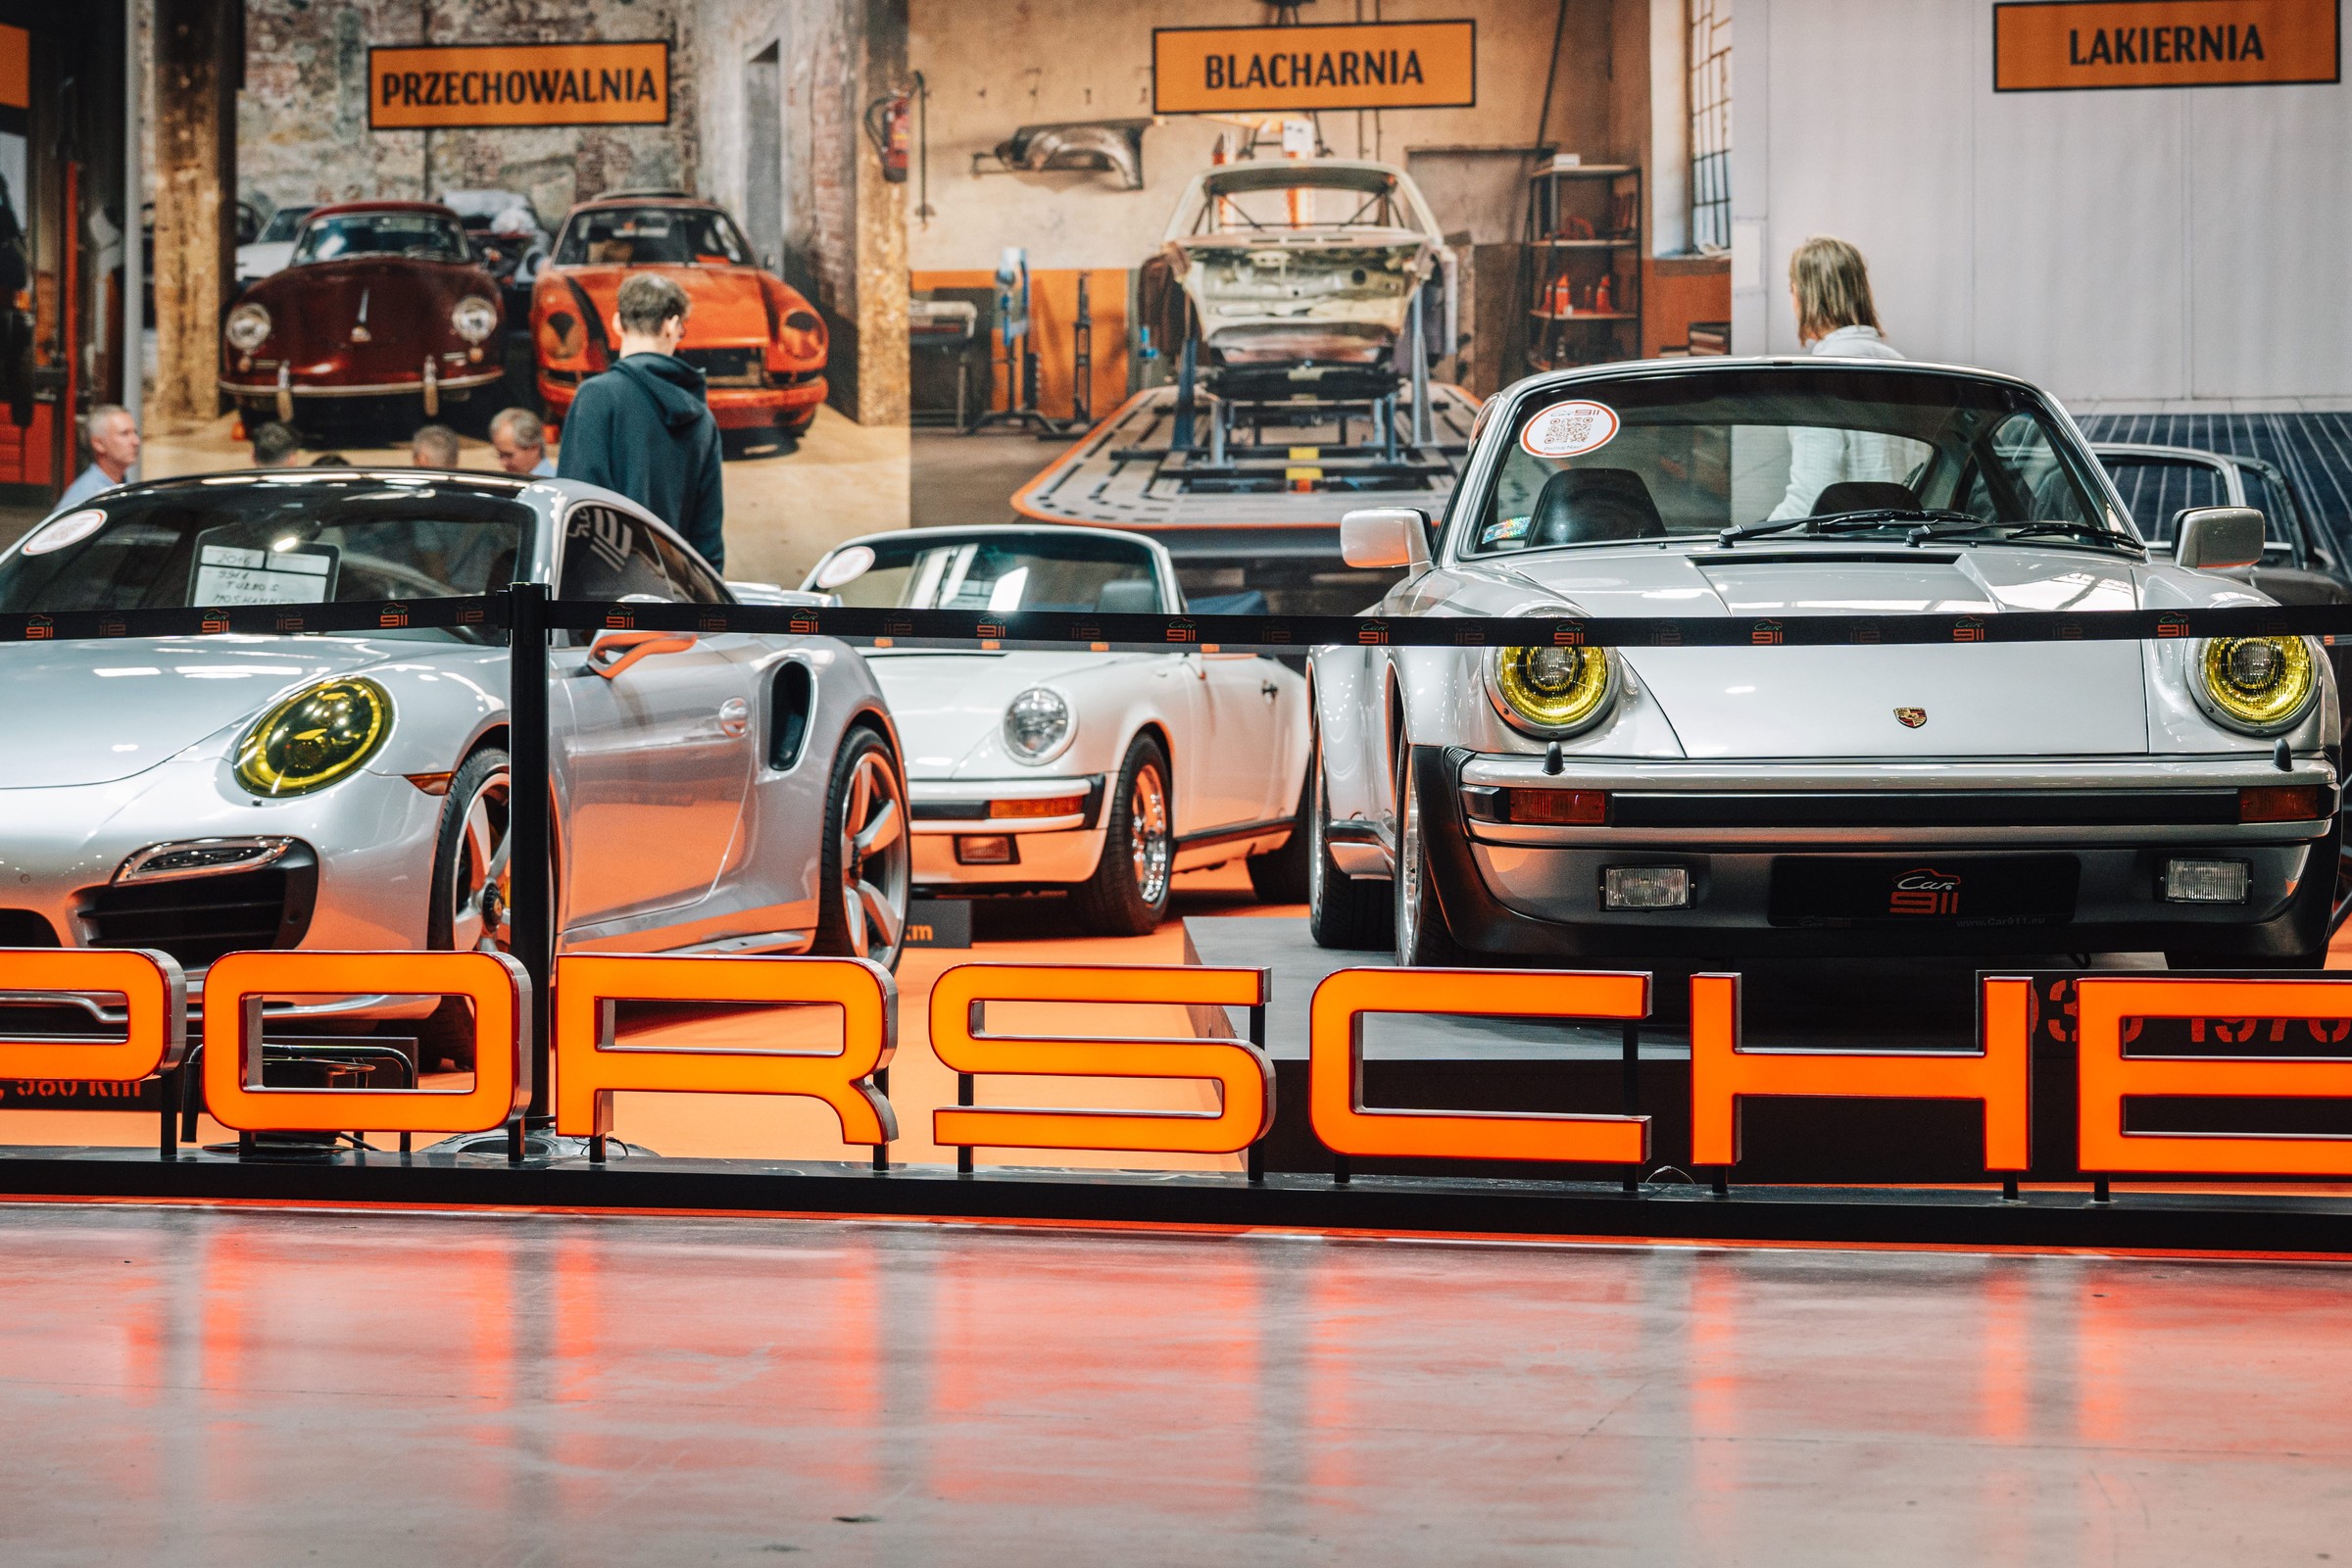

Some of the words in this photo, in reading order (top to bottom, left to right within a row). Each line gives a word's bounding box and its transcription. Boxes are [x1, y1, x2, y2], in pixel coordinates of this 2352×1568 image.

[2068, 24, 2266, 67] LAKIERNIA
[1203, 49, 1425, 90] BLACHARNIA
[380, 66, 660, 108] PRZECHOWALNIA
[202, 620, 229, 633] 911
[380, 614, 409, 627] 911
[607, 615, 634, 628] 911
[790, 620, 818, 633] 911
[26, 627, 53, 639] 911
[977, 624, 1005, 637] 911
[1167, 629, 1196, 642] 911
[1954, 628, 1984, 641] 911
[2158, 624, 2189, 637] 911
[1358, 631, 1388, 644] 911
[1554, 632, 1584, 645] 911
[1752, 632, 1783, 644] 911
[1888, 892, 1959, 914] 911
